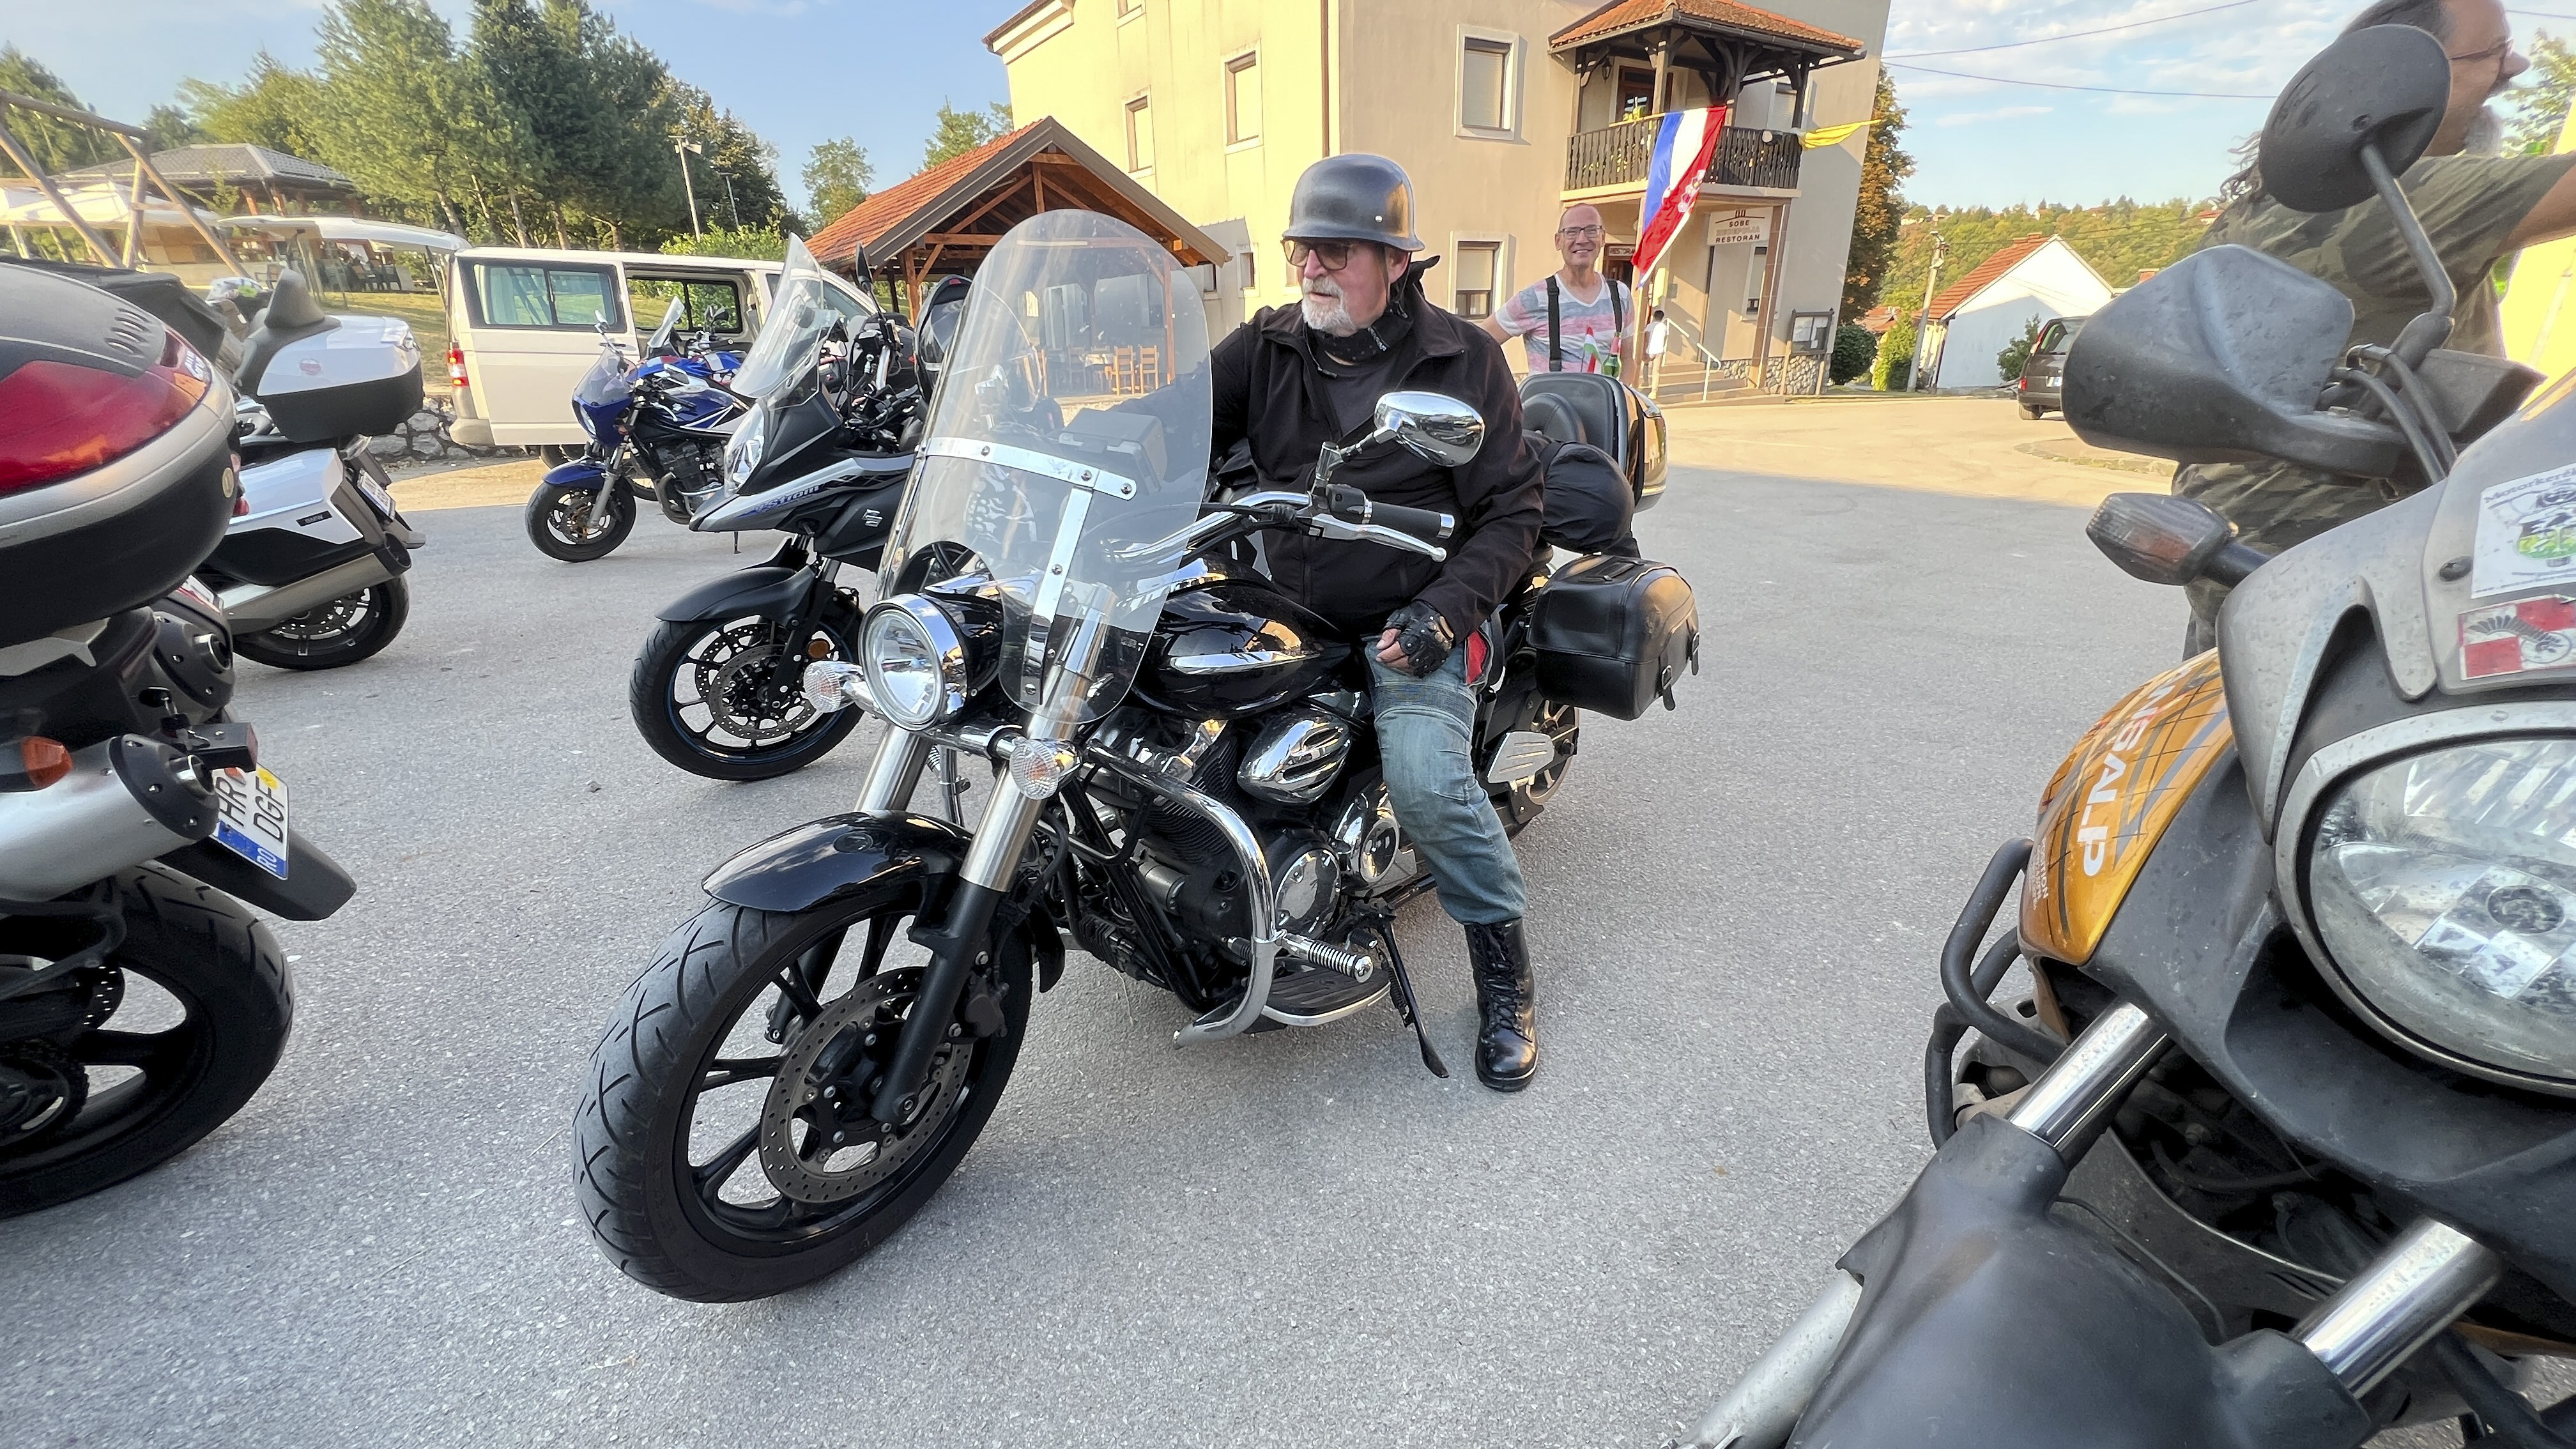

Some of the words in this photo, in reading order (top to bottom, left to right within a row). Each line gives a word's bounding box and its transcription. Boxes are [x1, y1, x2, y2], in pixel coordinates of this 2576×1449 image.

[1715, 234, 1760, 243] RESTORAN
[751, 484, 820, 514] V-Strom
[253, 776, 284, 844] DGF
[257, 847, 277, 873] RO
